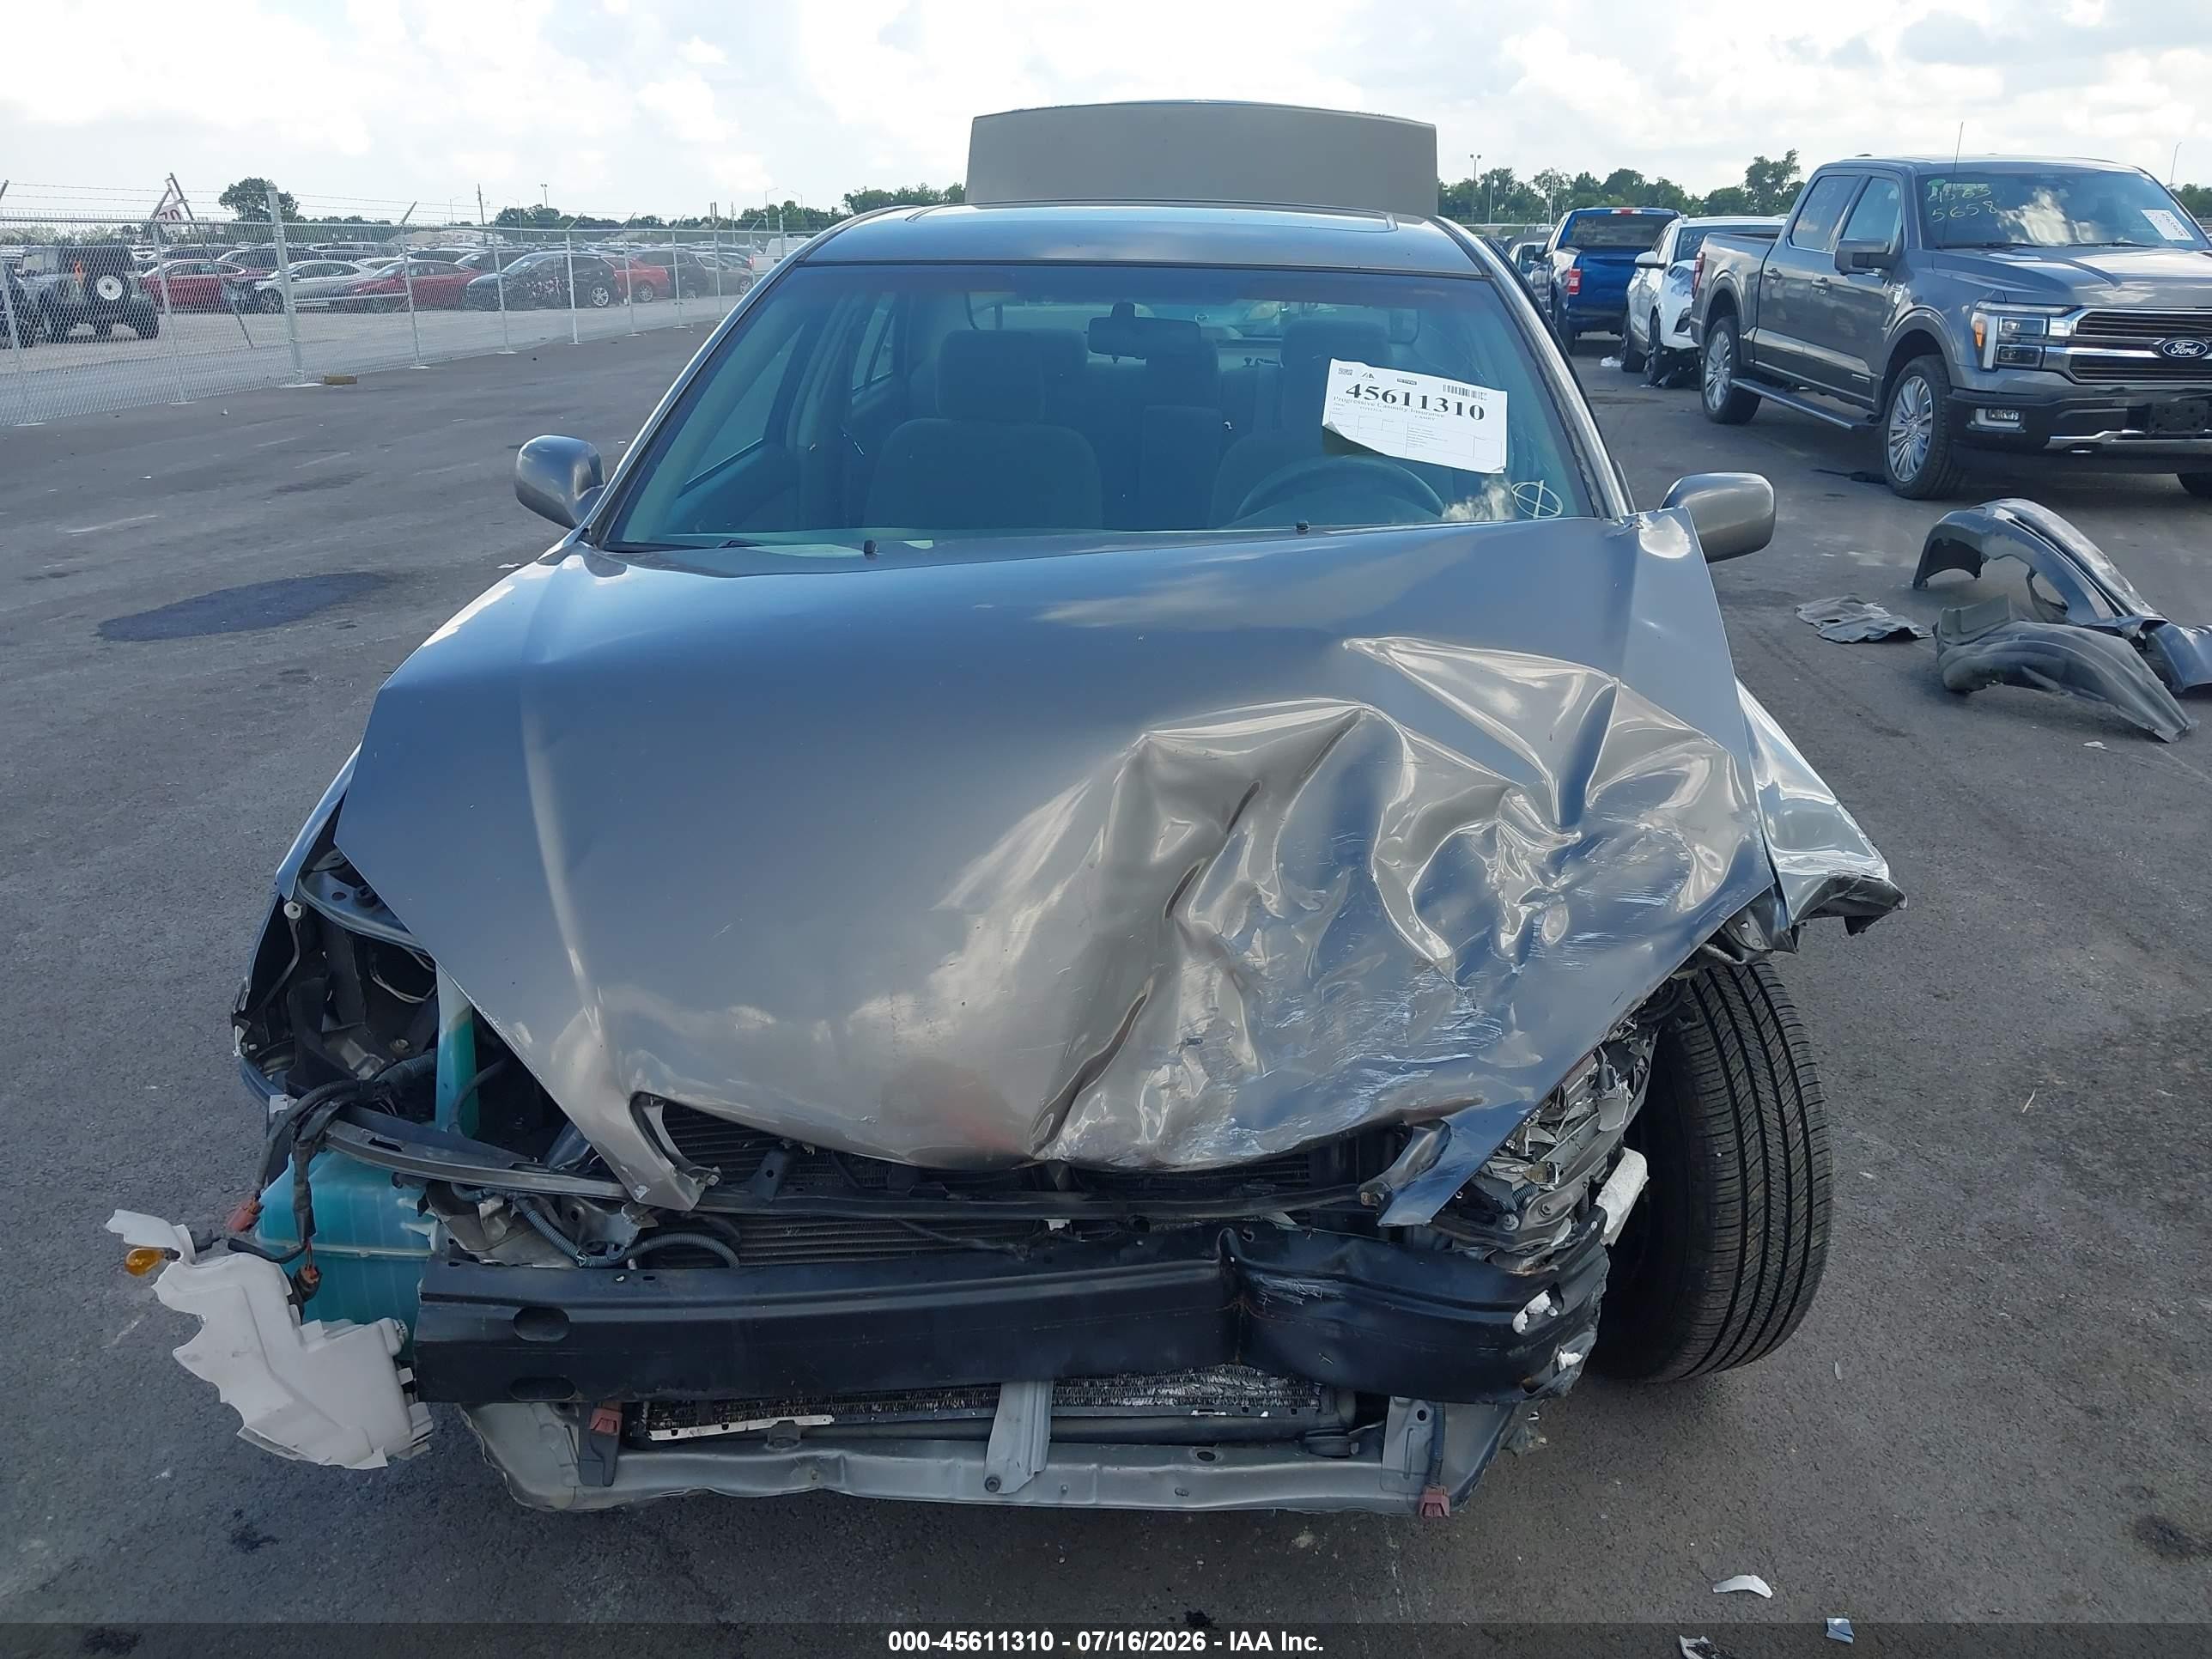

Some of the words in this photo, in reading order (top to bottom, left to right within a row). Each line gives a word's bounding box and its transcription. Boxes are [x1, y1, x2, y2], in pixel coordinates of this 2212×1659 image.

[1931, 200, 1998, 223] 5658
[2170, 342, 2200, 355] Ford
[1334, 396, 1376, 407] Progressive
[1345, 382, 1486, 421] 45611310
